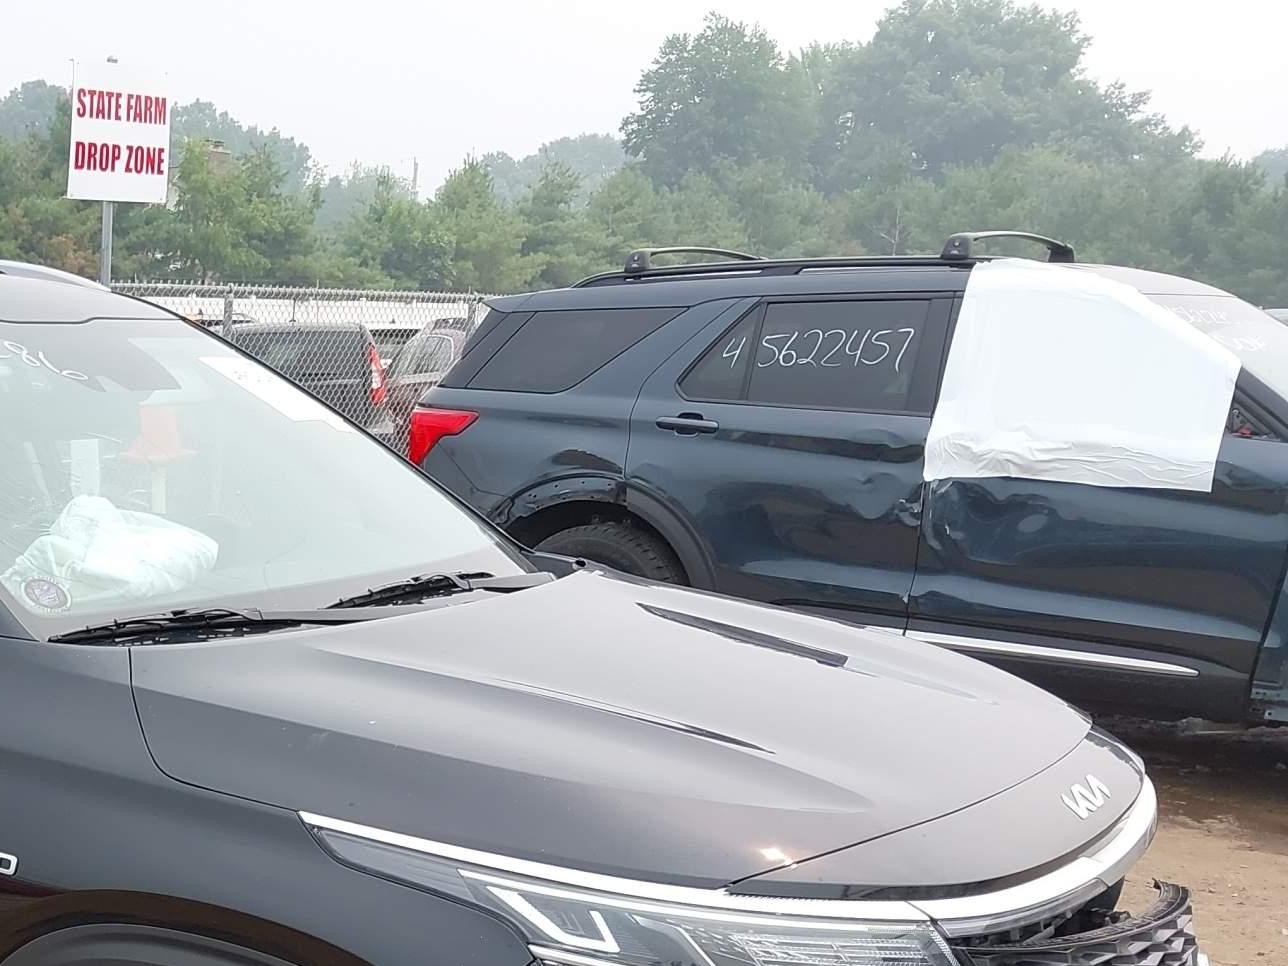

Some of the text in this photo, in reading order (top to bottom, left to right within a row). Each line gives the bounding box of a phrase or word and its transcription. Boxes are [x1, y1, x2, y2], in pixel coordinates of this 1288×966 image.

[76, 88, 167, 125] STATE FARM
[74, 141, 165, 175] DROP ZONE
